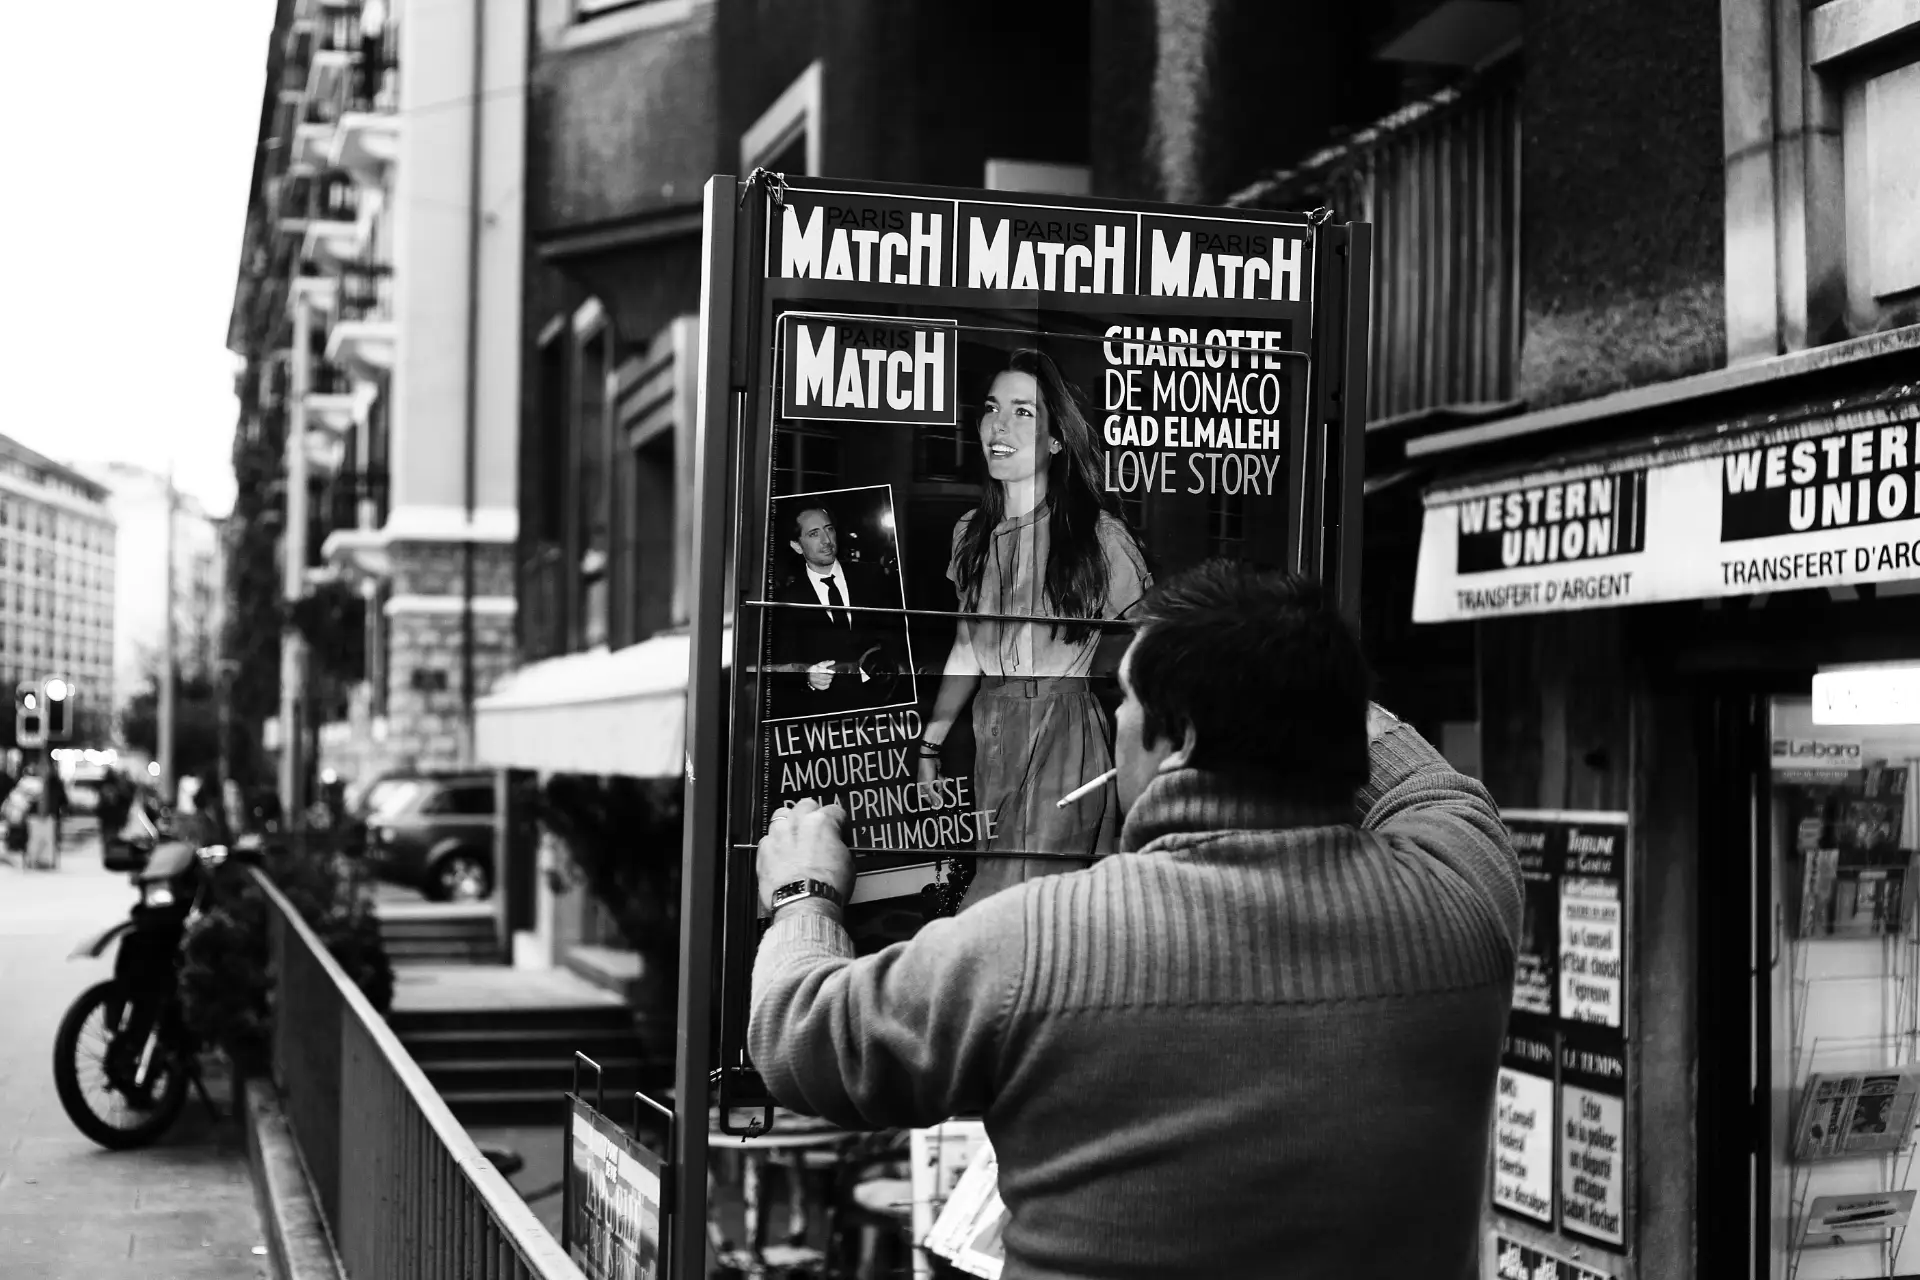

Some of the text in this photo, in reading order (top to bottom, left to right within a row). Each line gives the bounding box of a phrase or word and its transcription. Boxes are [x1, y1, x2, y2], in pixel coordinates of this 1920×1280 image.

[826, 206, 905, 231] PARIS
[1013, 219, 1089, 242] PARIS
[781, 203, 943, 287] MATCH
[968, 216, 1126, 295] MATCH
[1150, 228, 1303, 302] MATCH
[1194, 232, 1268, 256] PARIS
[839, 327, 910, 349] PARIS
[1103, 325, 1282, 370] CHARLOTTE
[795, 324, 945, 412] MATCH
[1105, 368, 1281, 415] DE MONACO
[1103, 414, 1280, 450] GAD ELMALEH
[1105, 450, 1281, 496] LOVE STORY
[1725, 421, 1920, 495] WESTER
[1460, 476, 1613, 535] WESTERN
[1788, 470, 1920, 532] UNIO
[1501, 516, 1612, 568] UNION
[1456, 571, 1633, 610] TRANSFERT D'ARGENT
[1720, 548, 1847, 586] TRANSFERT
[774, 709, 922, 757] LE WEEK-END
[780, 746, 911, 794] AMOUREUX
[848, 776, 971, 821] PRINCESSE
[852, 808, 999, 858] L'HUMORISTE
